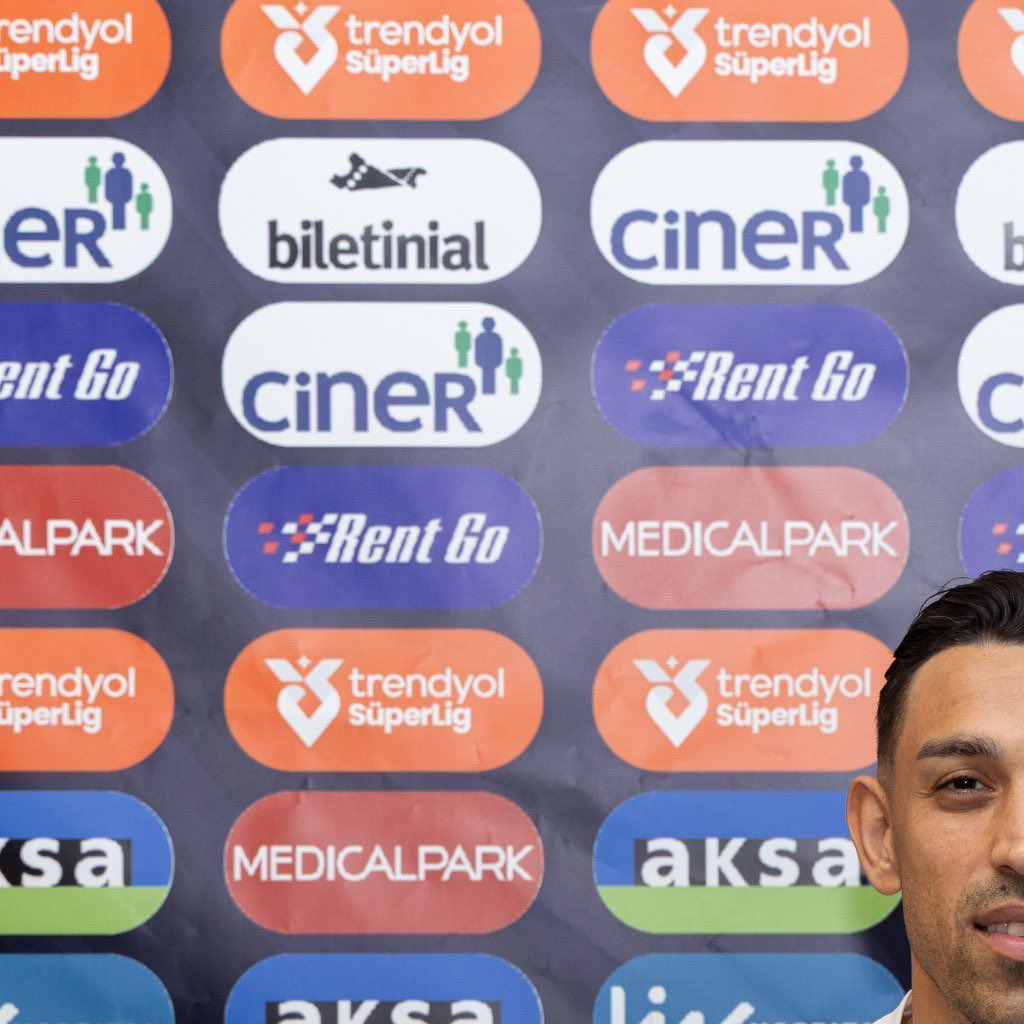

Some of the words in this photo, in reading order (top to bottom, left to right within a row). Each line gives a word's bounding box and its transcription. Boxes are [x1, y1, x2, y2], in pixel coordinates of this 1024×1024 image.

[0, 11, 133, 51] rendyol
[345, 14, 503, 53] trendyol
[713, 16, 872, 55] trendyol
[0, 45, 100, 81] üperLig
[267, 219, 489, 271] biletinial
[0, 354, 74, 401] ent
[74, 348, 141, 401] Go
[692, 351, 809, 402] Rent
[811, 349, 876, 402] Go
[0, 518, 164, 557] ALPARK
[324, 513, 443, 564] Rent
[444, 512, 510, 564] Go
[601, 519, 899, 557] MEDICALPARK
[0, 666, 136, 704] rendyol
[348, 666, 505, 705] trendyol
[715, 666, 872, 705] trendyol
[0, 699, 103, 735] üperLig
[233, 844, 534, 882] MEDICALPARK
